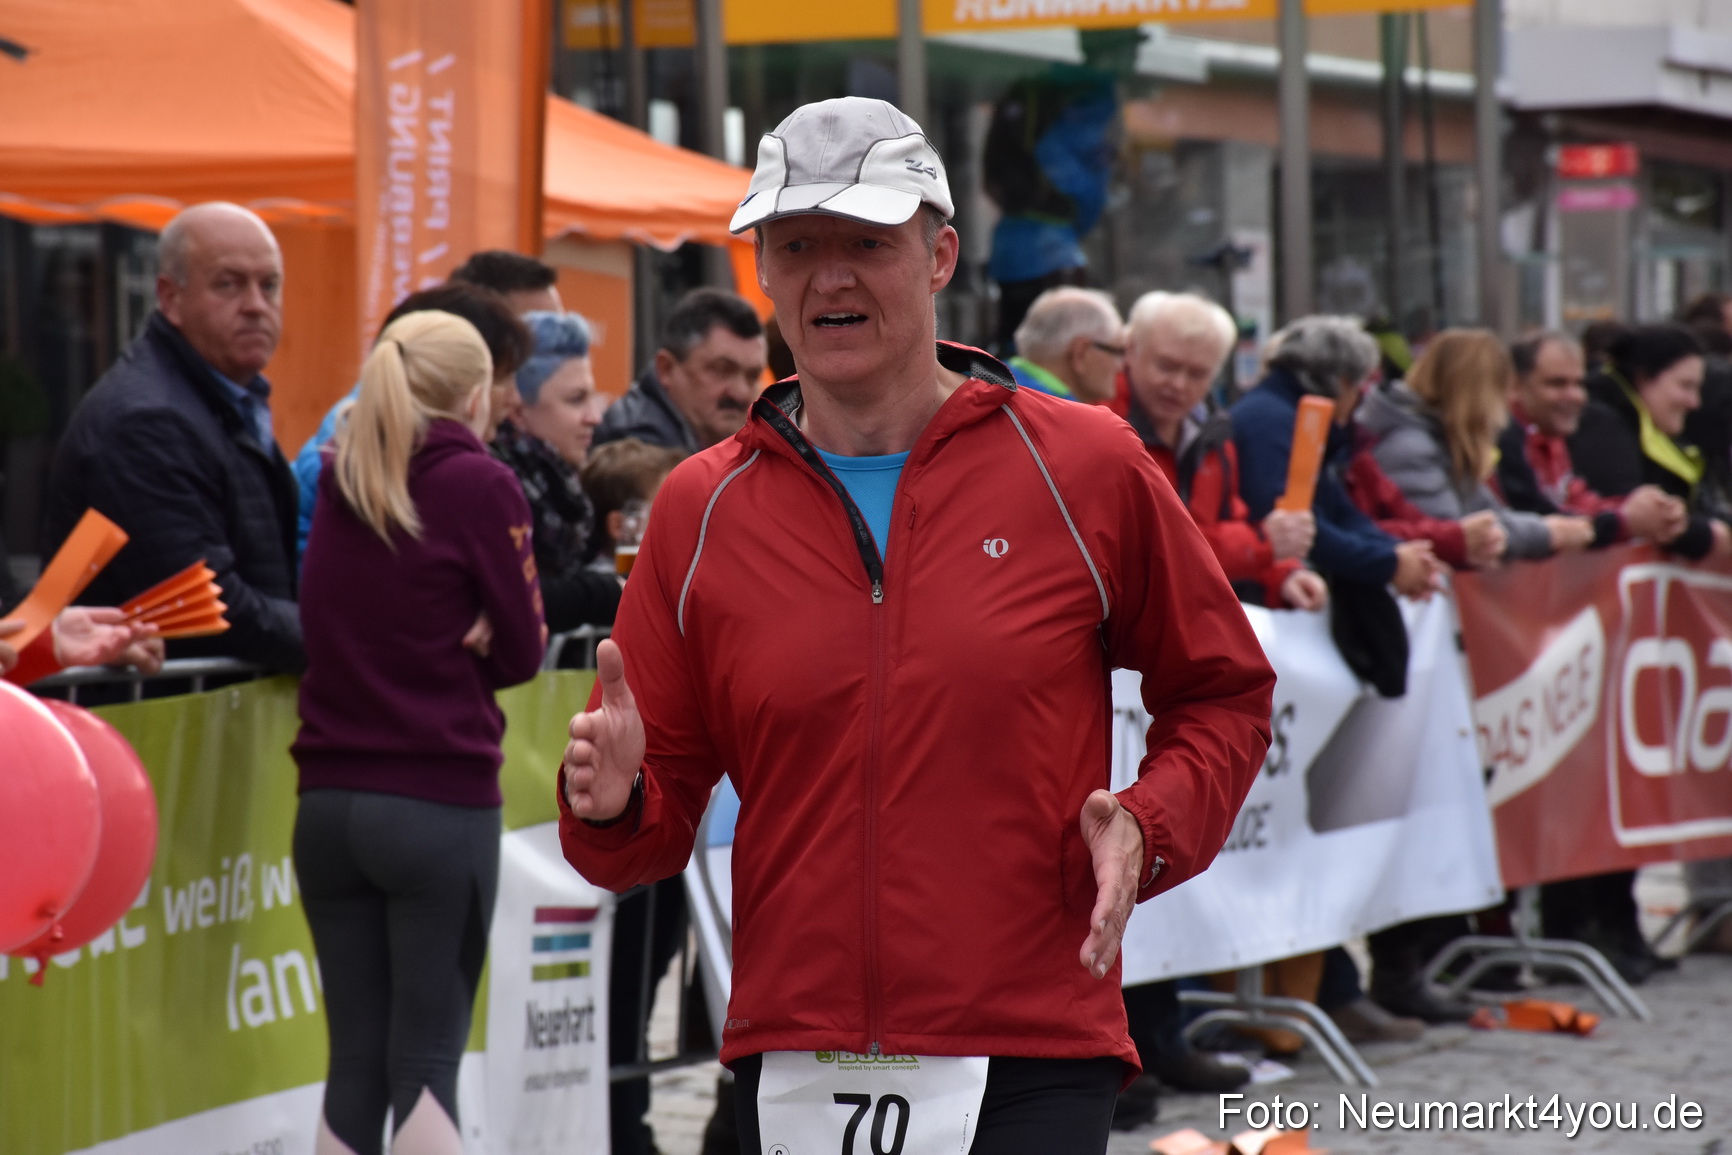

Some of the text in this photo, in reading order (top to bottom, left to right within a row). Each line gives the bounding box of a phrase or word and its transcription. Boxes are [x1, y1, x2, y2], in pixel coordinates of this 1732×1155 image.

[904, 157, 938, 180] Z4
[163, 852, 254, 935] weiß,
[261, 855, 302, 911] w
[226, 942, 323, 1032] lan
[892, 1064, 920, 1072] concepts
[833, 1092, 911, 1155] 70
